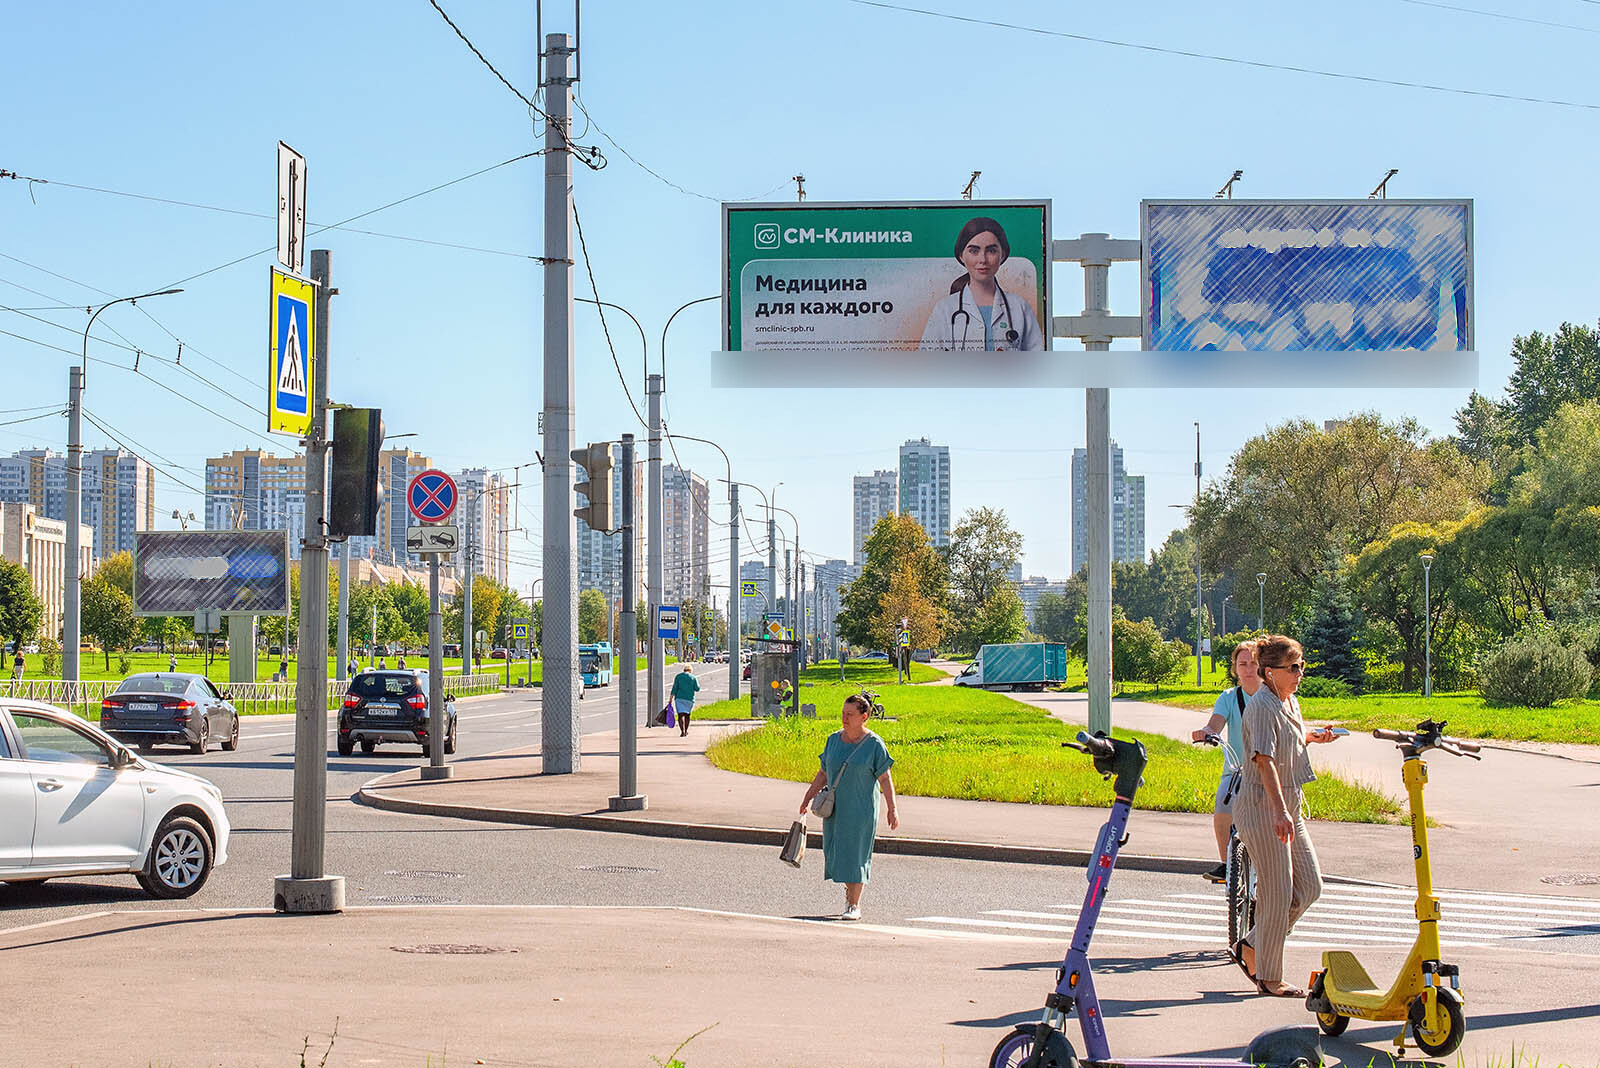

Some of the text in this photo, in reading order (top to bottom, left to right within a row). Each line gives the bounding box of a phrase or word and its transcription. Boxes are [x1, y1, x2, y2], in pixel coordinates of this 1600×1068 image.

[784, 228, 913, 244] СМ-Клиника
[756, 275, 867, 294] Медицина
[755, 301, 894, 318] для каждого
[755, 325, 815, 334] smclinic-spb.ru
[1105, 825, 1117, 854] ЮРЕНТ
